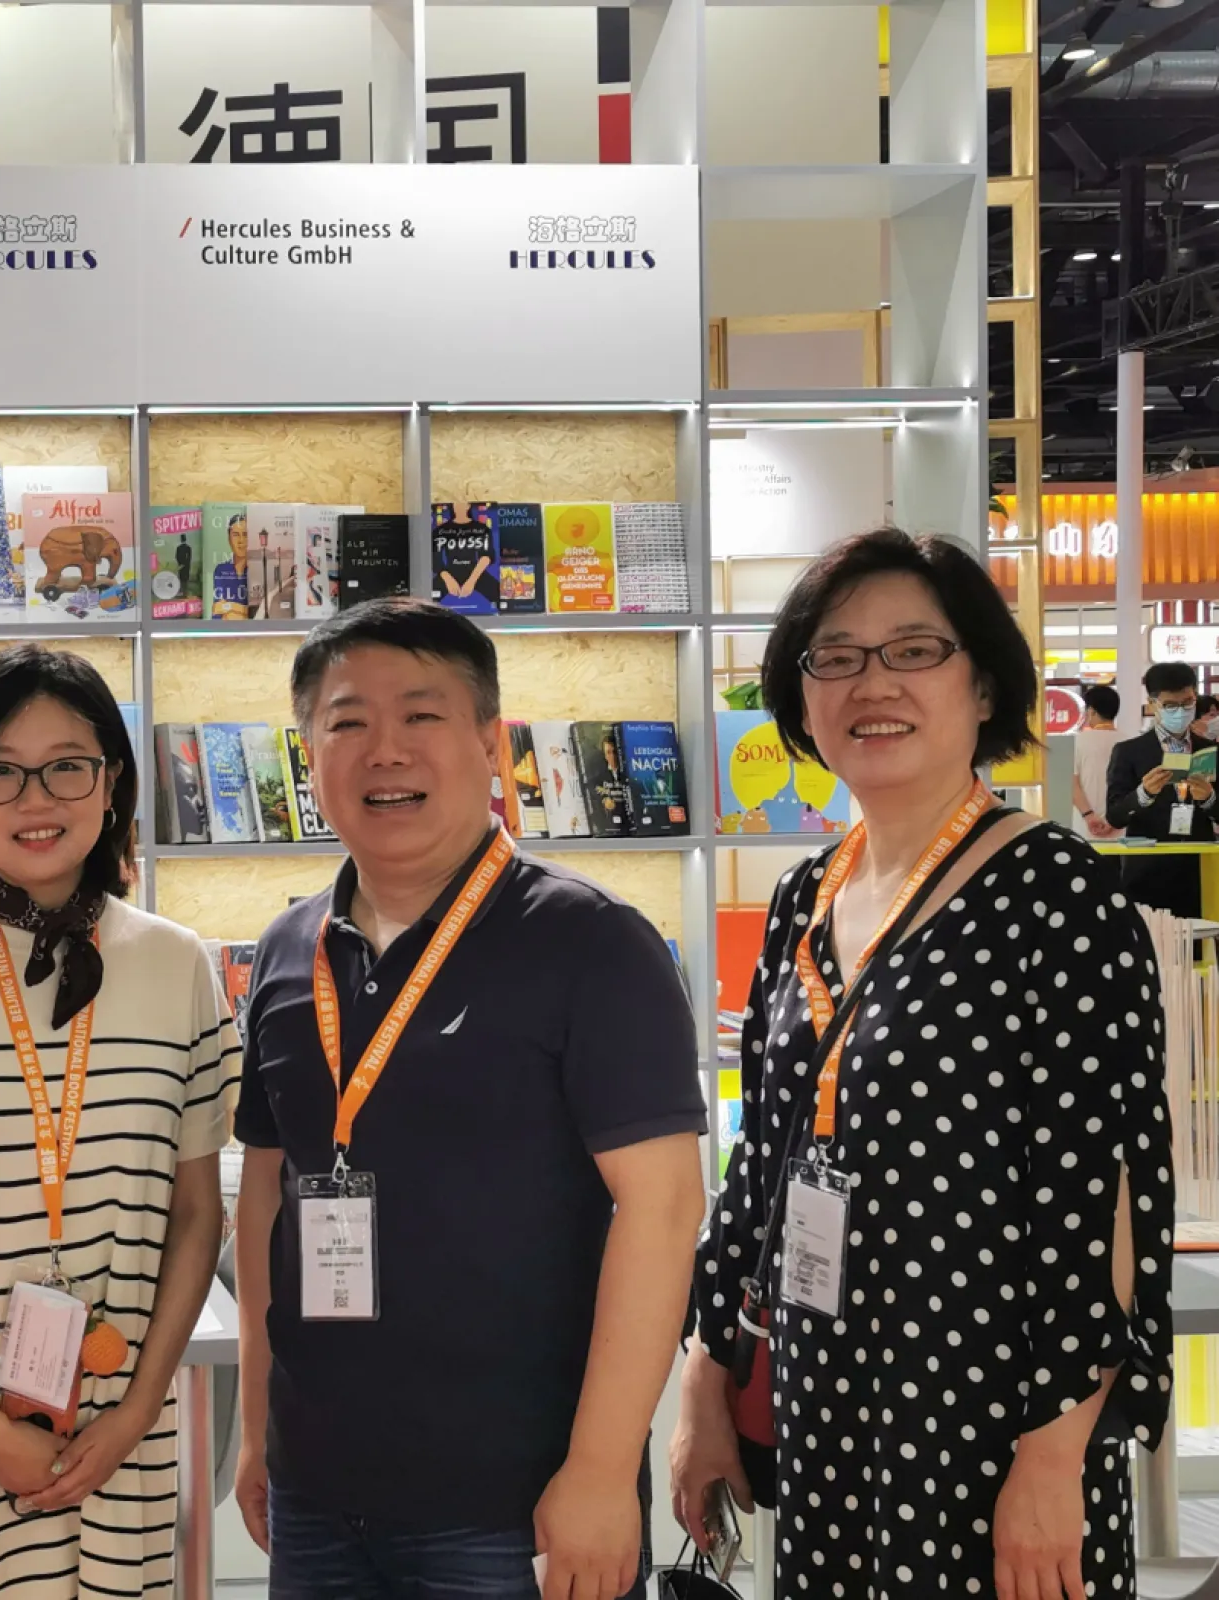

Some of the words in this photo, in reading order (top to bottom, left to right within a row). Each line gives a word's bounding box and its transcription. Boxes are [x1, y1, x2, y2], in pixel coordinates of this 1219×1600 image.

[201, 218, 292, 239] Hercules
[301, 218, 391, 239] Business
[400, 218, 415, 239] &
[528, 216, 636, 243] 海格立斯
[201, 244, 279, 265] Culture
[287, 244, 352, 265] GmbH
[509, 250, 656, 269] HERCULES
[764, 473, 792, 484] Affairs
[48, 498, 102, 525] Alfred
[561, 556, 601, 567] GEIGER
[564, 546, 596, 556] ARNO
[213, 584, 248, 601] GLÜ
[631, 757, 678, 771] NACHT
[736, 743, 786, 763] SOM
[912, 836, 953, 882] BEIJING
[466, 860, 498, 901] BEIJING
[413, 899, 473, 985] INTERNATIONAL
[0, 977, 24, 1023] BEIJING
[392, 984, 420, 1020] BOOK
[363, 1018, 400, 1071] FESTIVAL
[66, 1073, 82, 1108] BOOK
[60, 1110, 77, 1163] FESTIVAL
